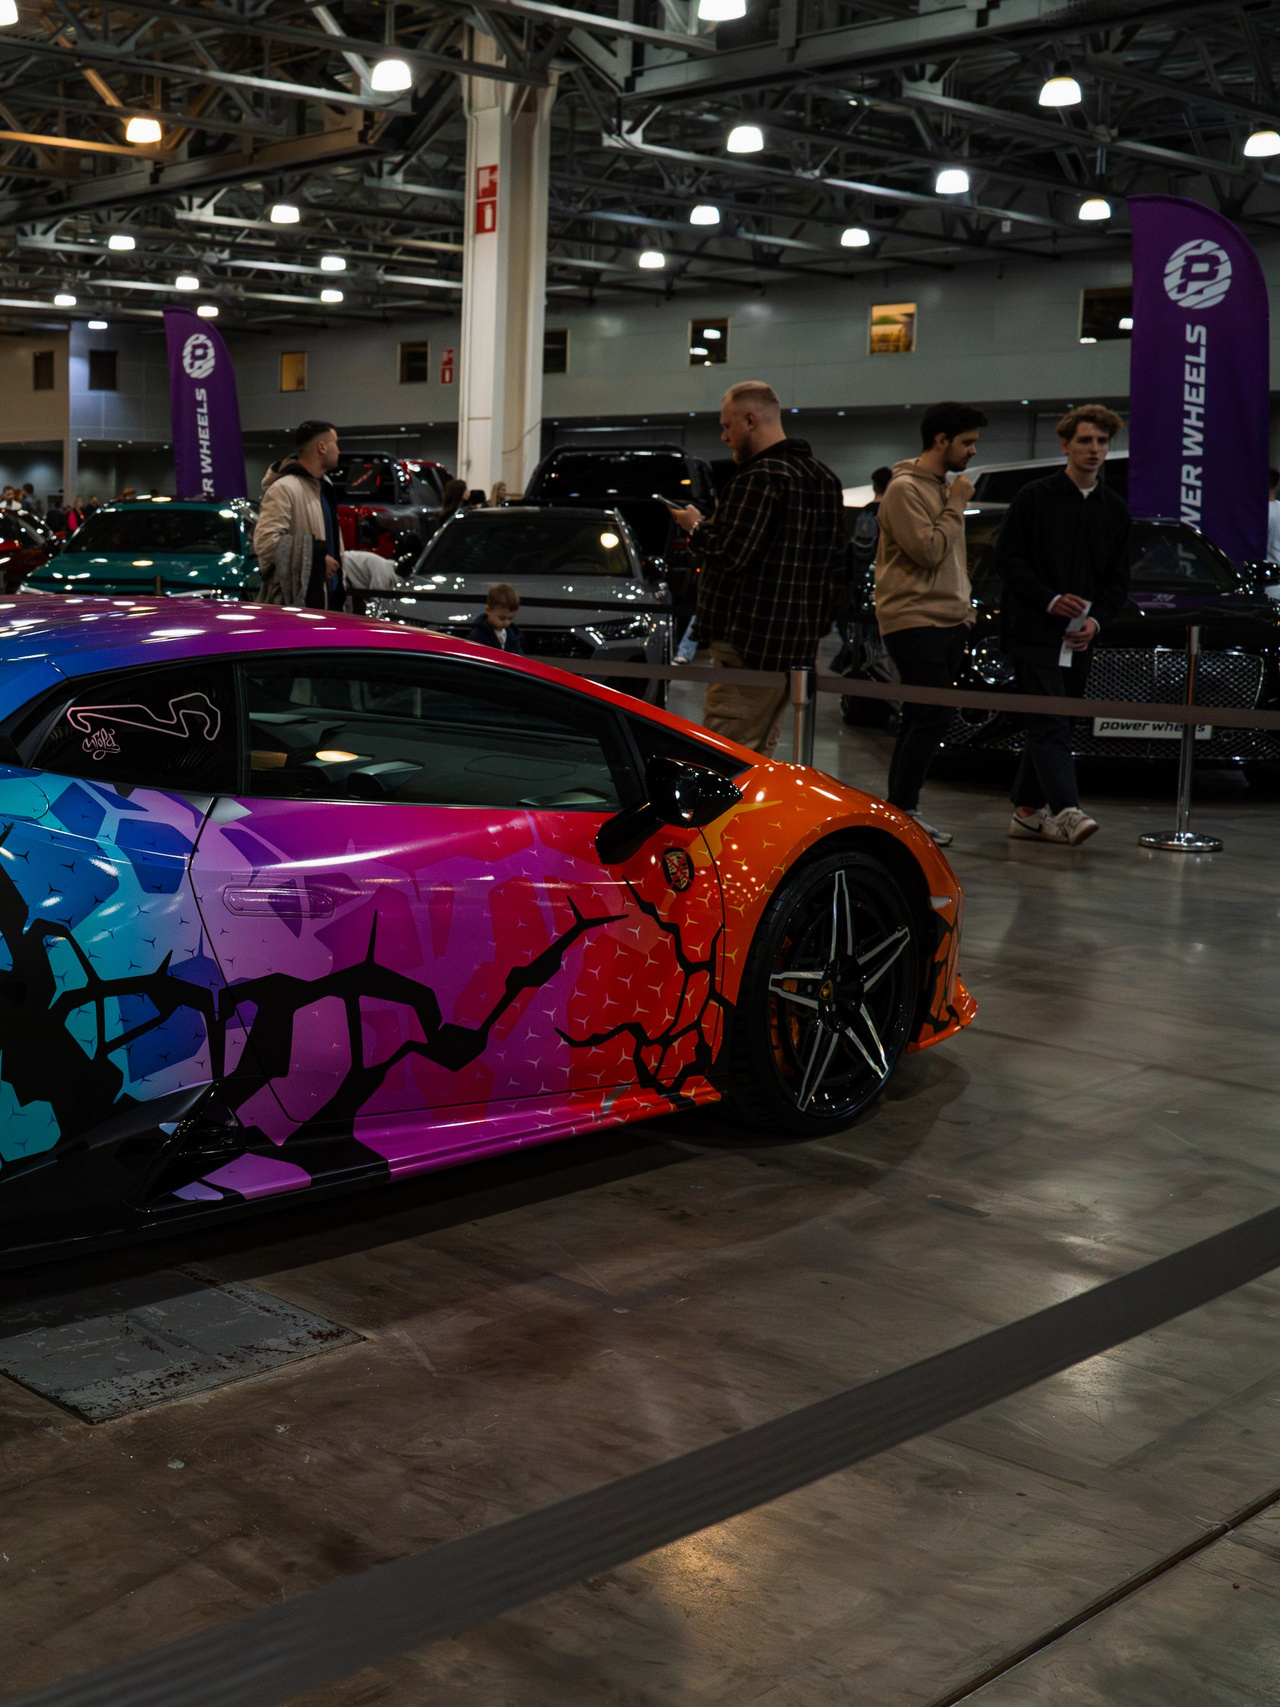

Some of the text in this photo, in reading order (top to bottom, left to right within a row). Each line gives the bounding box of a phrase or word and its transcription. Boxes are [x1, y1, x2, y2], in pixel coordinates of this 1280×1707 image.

[195, 387, 213, 474] WHEELS
[1182, 323, 1207, 457] WHEELS
[1099, 721, 1206, 733] power whes
